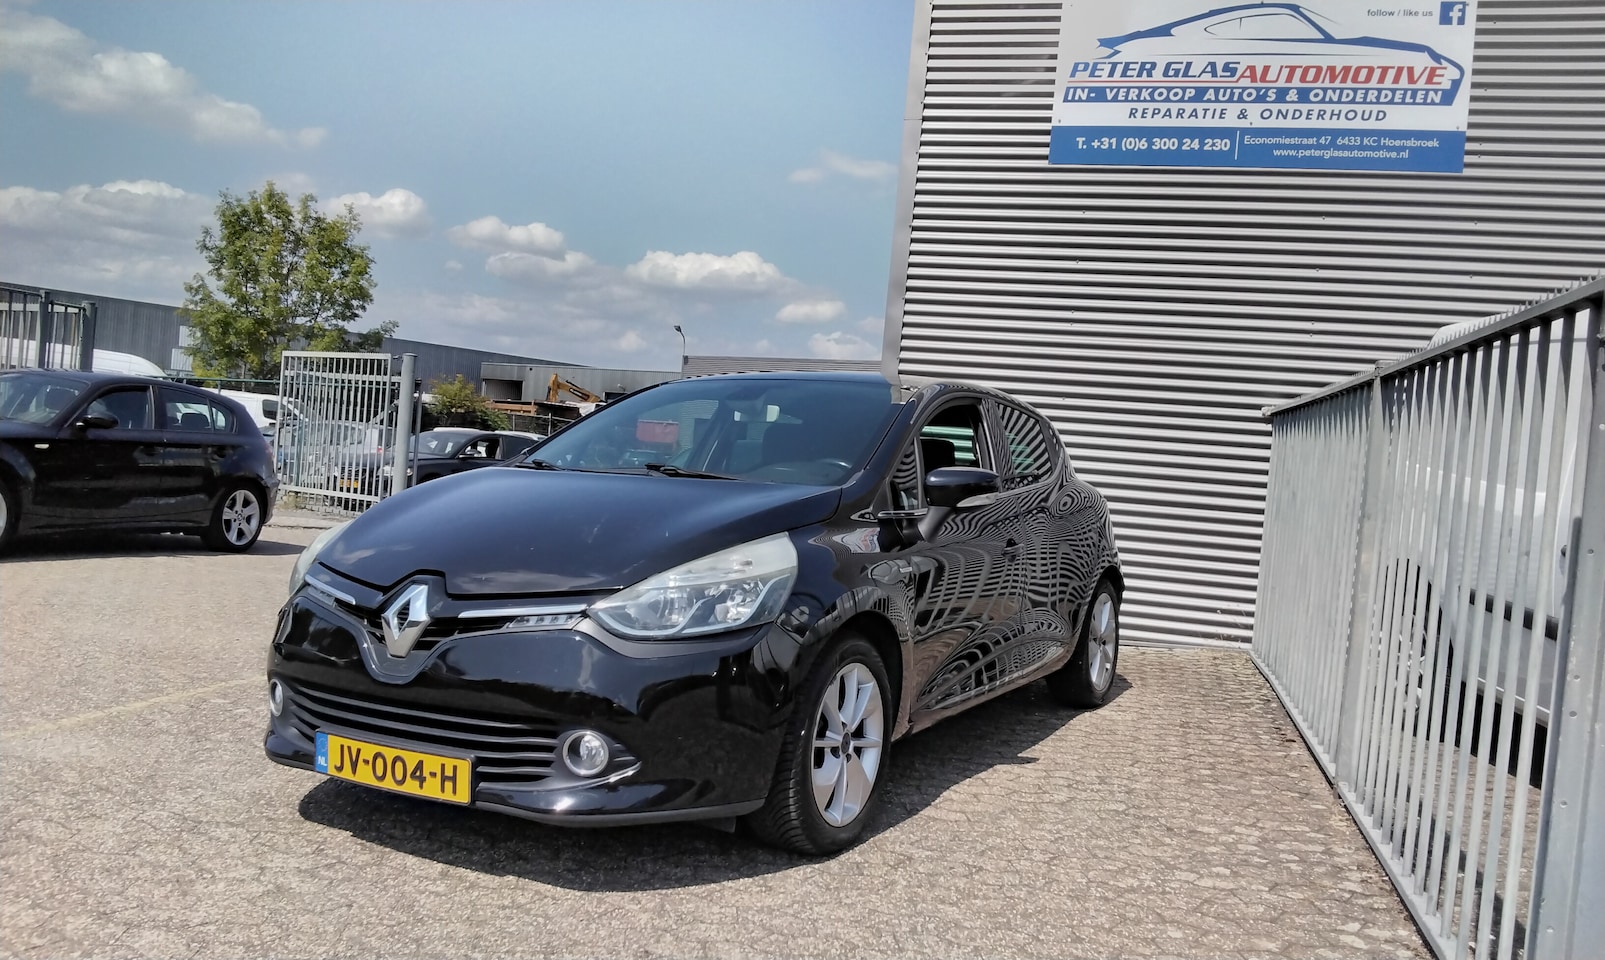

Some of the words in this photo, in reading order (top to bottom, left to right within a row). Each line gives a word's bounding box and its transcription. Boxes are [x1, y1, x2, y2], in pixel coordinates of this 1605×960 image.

[1367, 9, 1395, 17] follow
[1403, 9, 1420, 17] like
[1069, 61, 1158, 78] PETER
[1067, 88, 1097, 101] IN-
[1105, 88, 1196, 101] VERKOOP
[1203, 88, 1277, 102] AUTO'S
[1286, 89, 1299, 101] &
[1309, 89, 1443, 103] ONDERDELEN
[1128, 107, 1228, 120] REPARATIE
[1237, 108, 1249, 120] &
[1260, 108, 1387, 121] ONDERHOUD
[1076, 137, 1087, 149] T.
[1091, 137, 1117, 149] +31
[1121, 137, 1148, 151] (0)6
[1152, 137, 1178, 150] 300
[1181, 138, 1200, 150] 24
[1203, 138, 1231, 151] 230
[1244, 135, 1317, 145] Economiestraat
[1319, 136, 1331, 145] 47
[1337, 136, 1361, 146] 6433
[1363, 136, 1378, 146] KC
[1380, 137, 1439, 148] Hoensbroek
[1273, 148, 1409, 159] www.peterglasautomotive.nl
[317, 755, 328, 767] NL
[334, 744, 458, 796] JV-004-H
